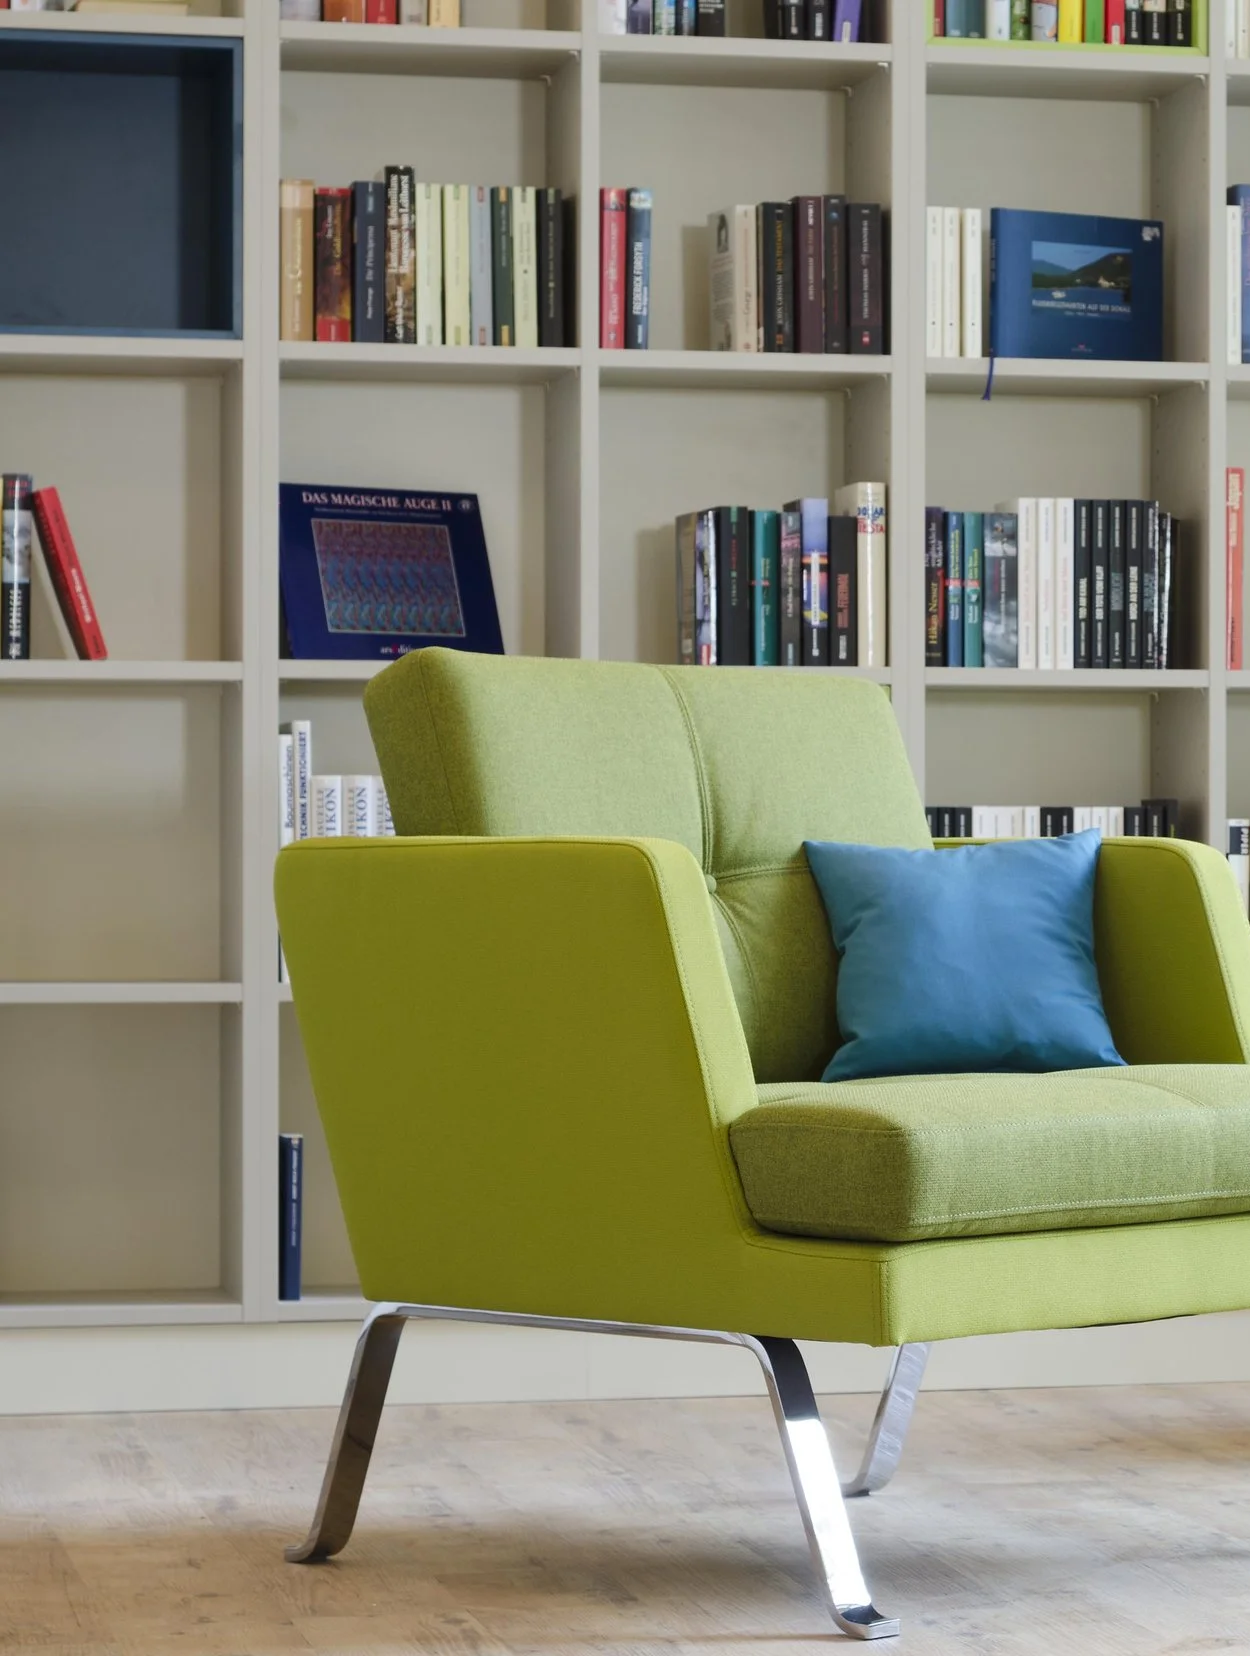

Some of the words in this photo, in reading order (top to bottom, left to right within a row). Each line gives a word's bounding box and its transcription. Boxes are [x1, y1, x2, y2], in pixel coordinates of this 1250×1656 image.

[301, 490, 329, 504] DAS
[331, 493, 402, 509] MAGISCHE
[403, 498, 440, 511] AUGE
[442, 500, 454, 512] II
[928, 614, 938, 645] Håkan
[283, 745, 295, 829] Baumaschinen
[298, 731, 308, 799] FUNKTIONIERT
[315, 788, 324, 836] ISUELLE
[325, 787, 336, 833] IKON
[347, 787, 355, 835] ISUELLE
[355, 786, 367, 833] IKON
[375, 788, 384, 836] ISUELLE
[1240, 828, 1250, 855] PIPER
